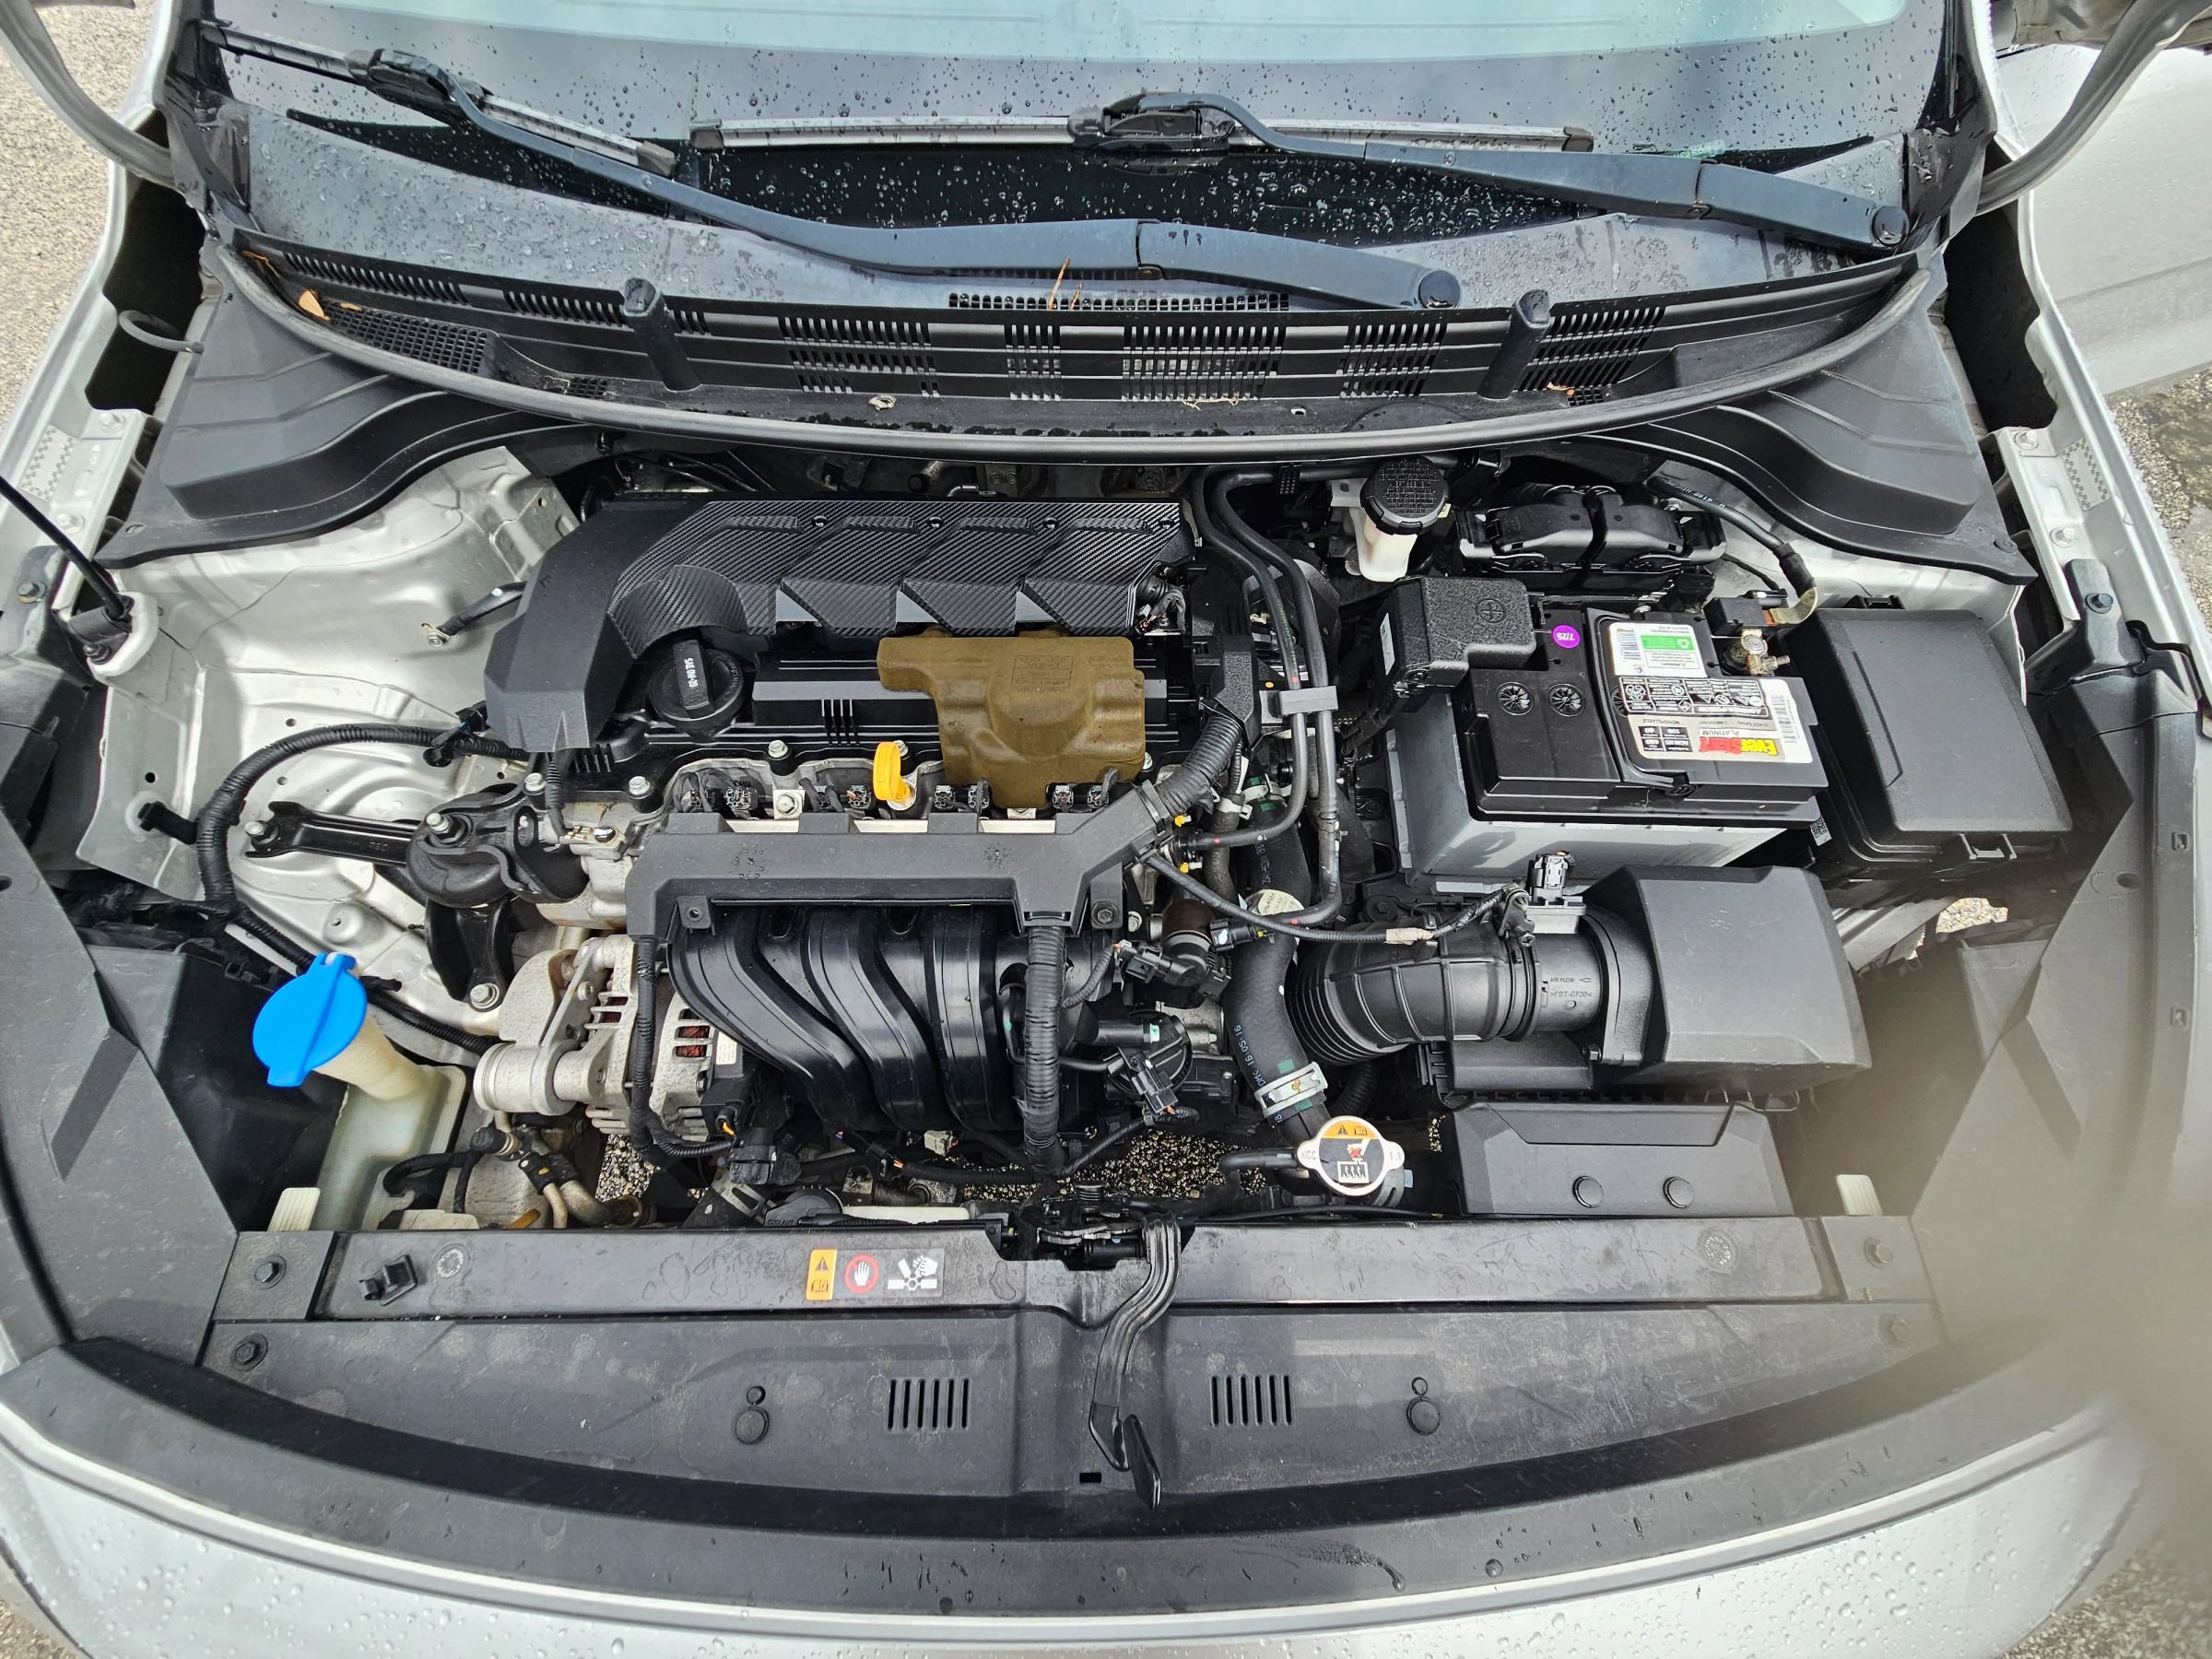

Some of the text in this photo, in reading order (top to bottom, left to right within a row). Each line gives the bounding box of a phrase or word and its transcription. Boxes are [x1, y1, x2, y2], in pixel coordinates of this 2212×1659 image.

[1556, 631, 1576, 641] 7/25
[685, 658, 698, 687] SAE 0W-20
[1700, 737, 1778, 755] EverStart
